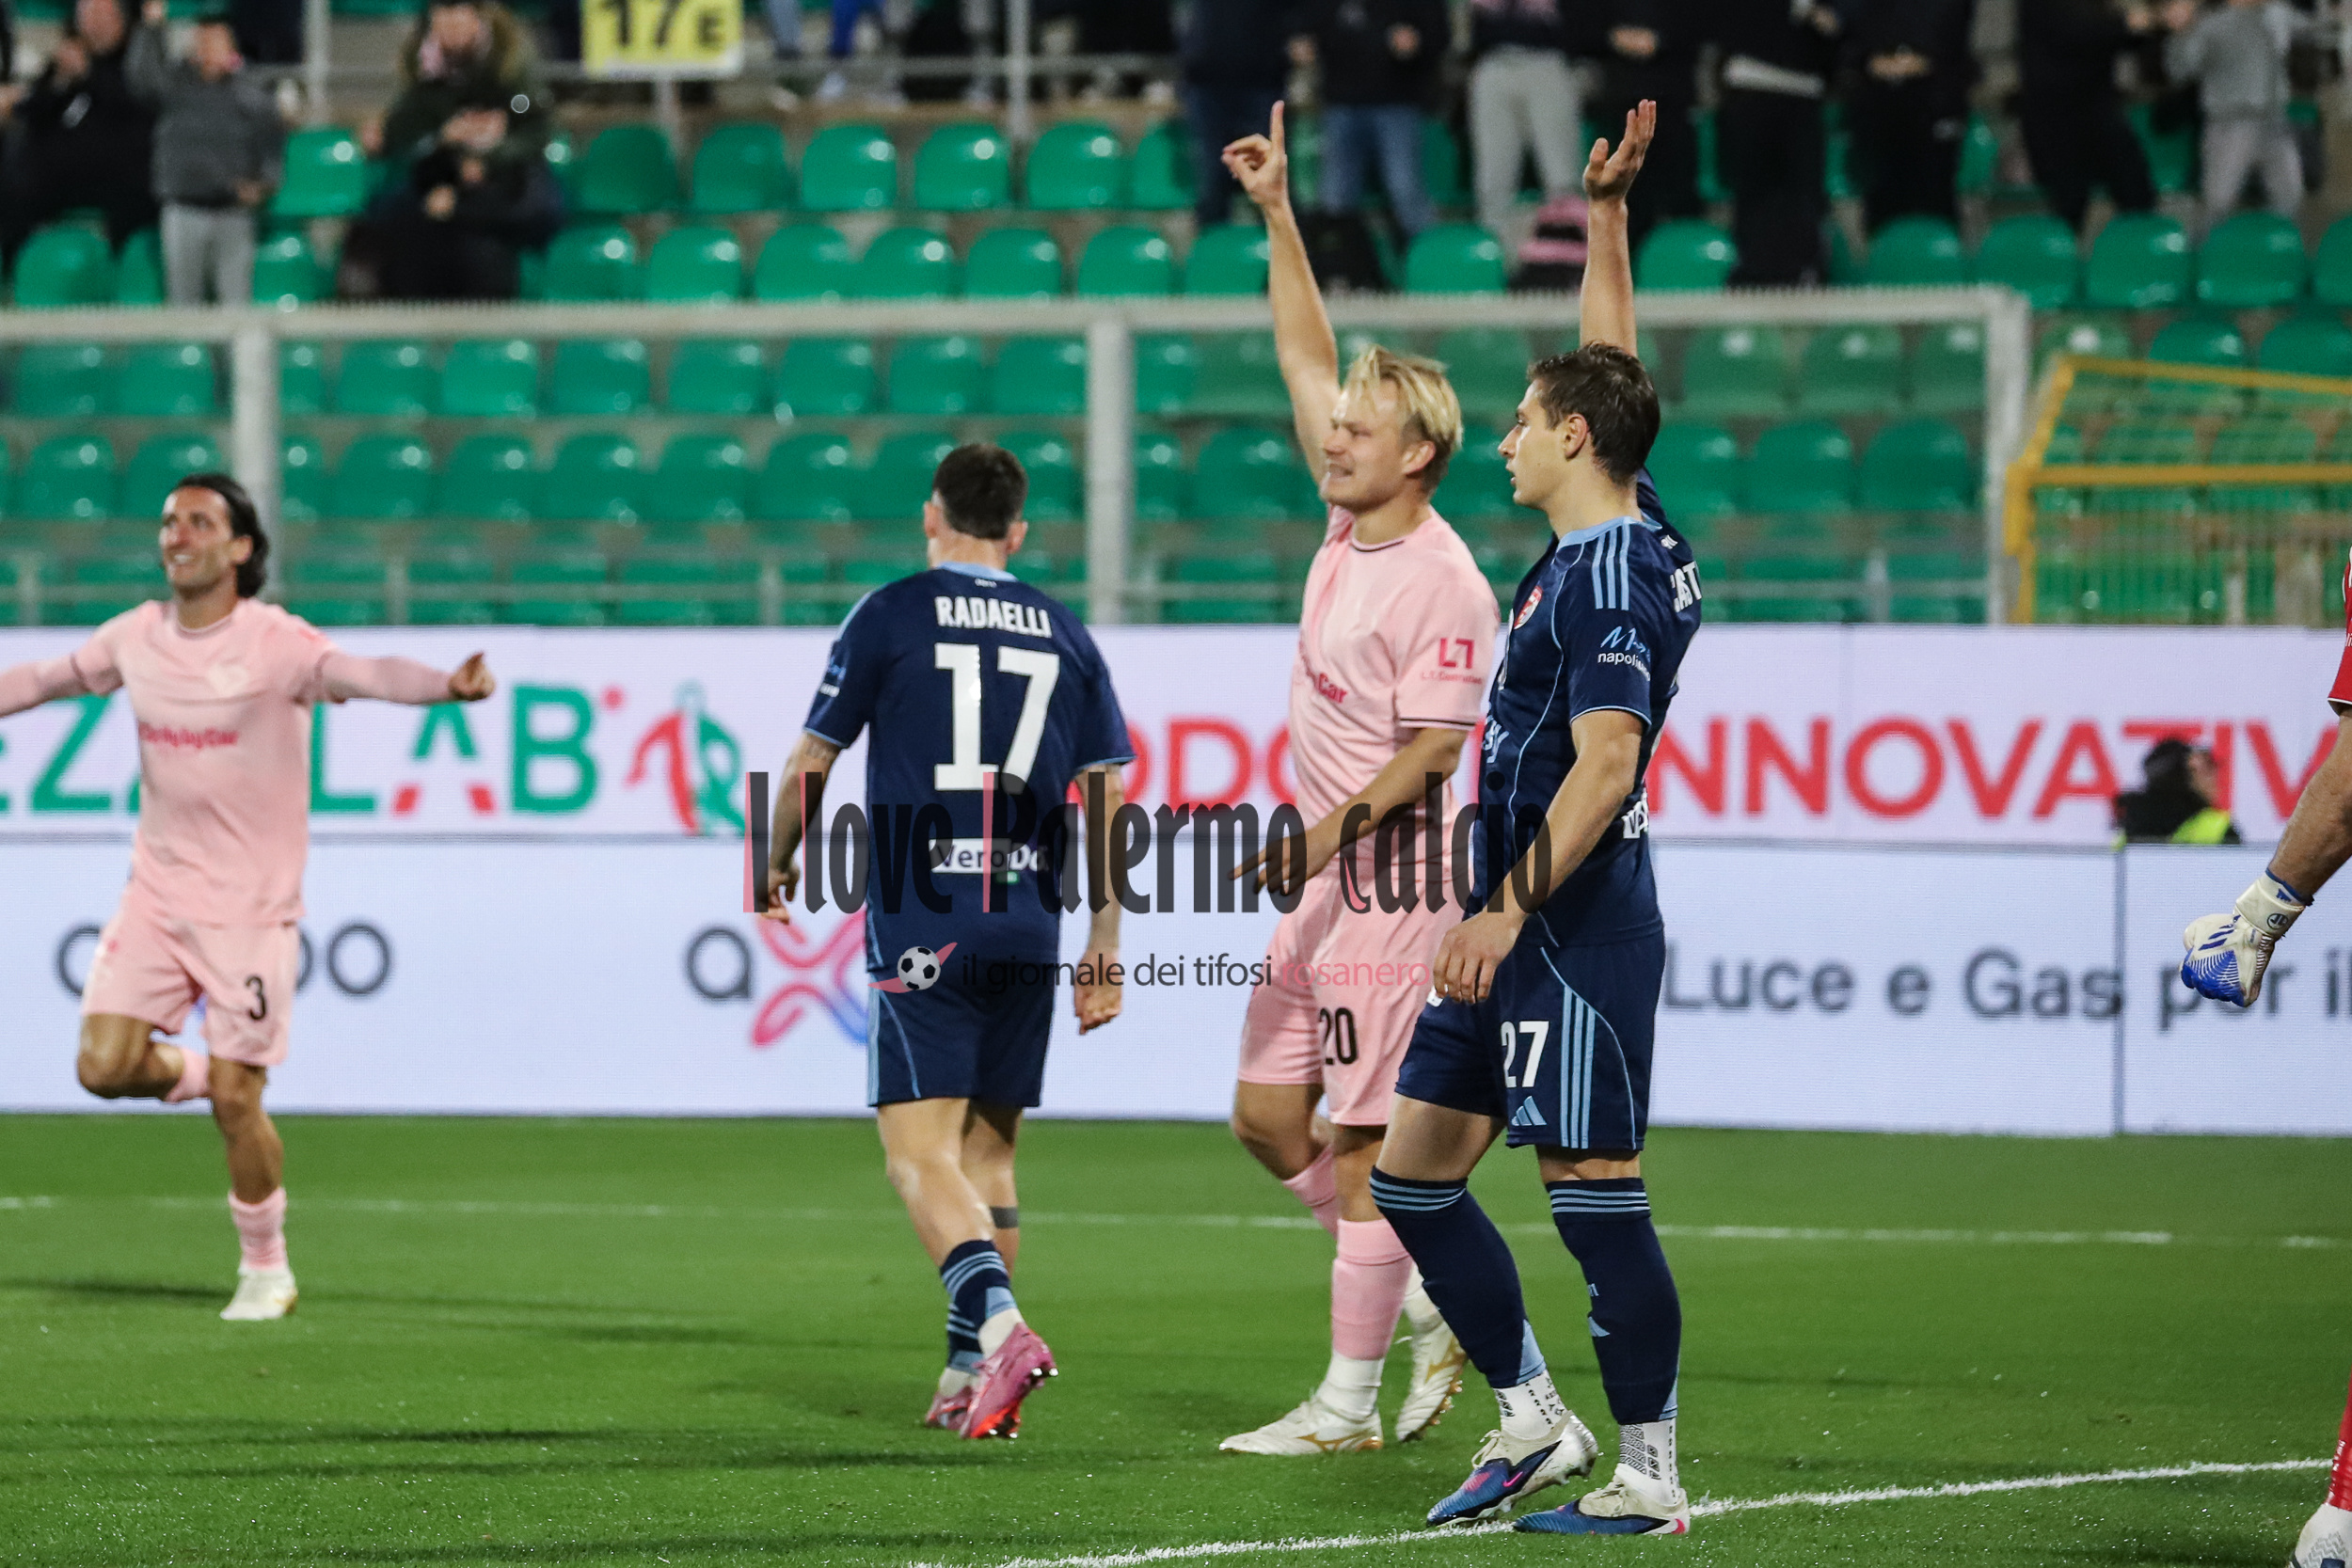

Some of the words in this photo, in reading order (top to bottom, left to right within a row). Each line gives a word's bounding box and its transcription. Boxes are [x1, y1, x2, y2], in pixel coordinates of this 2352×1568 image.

[934, 595, 1053, 639] RADAELLI
[934, 641, 1061, 796] 17
[246, 974, 267, 1022] 3
[1662, 941, 1856, 1013] Luce
[1887, 964, 1931, 1016] e
[1964, 947, 2124, 1020] Gas
[2159, 965, 2296, 1032] pr
[1318, 1006, 1359, 1065] 20
[1500, 1020, 1550, 1089] 27
